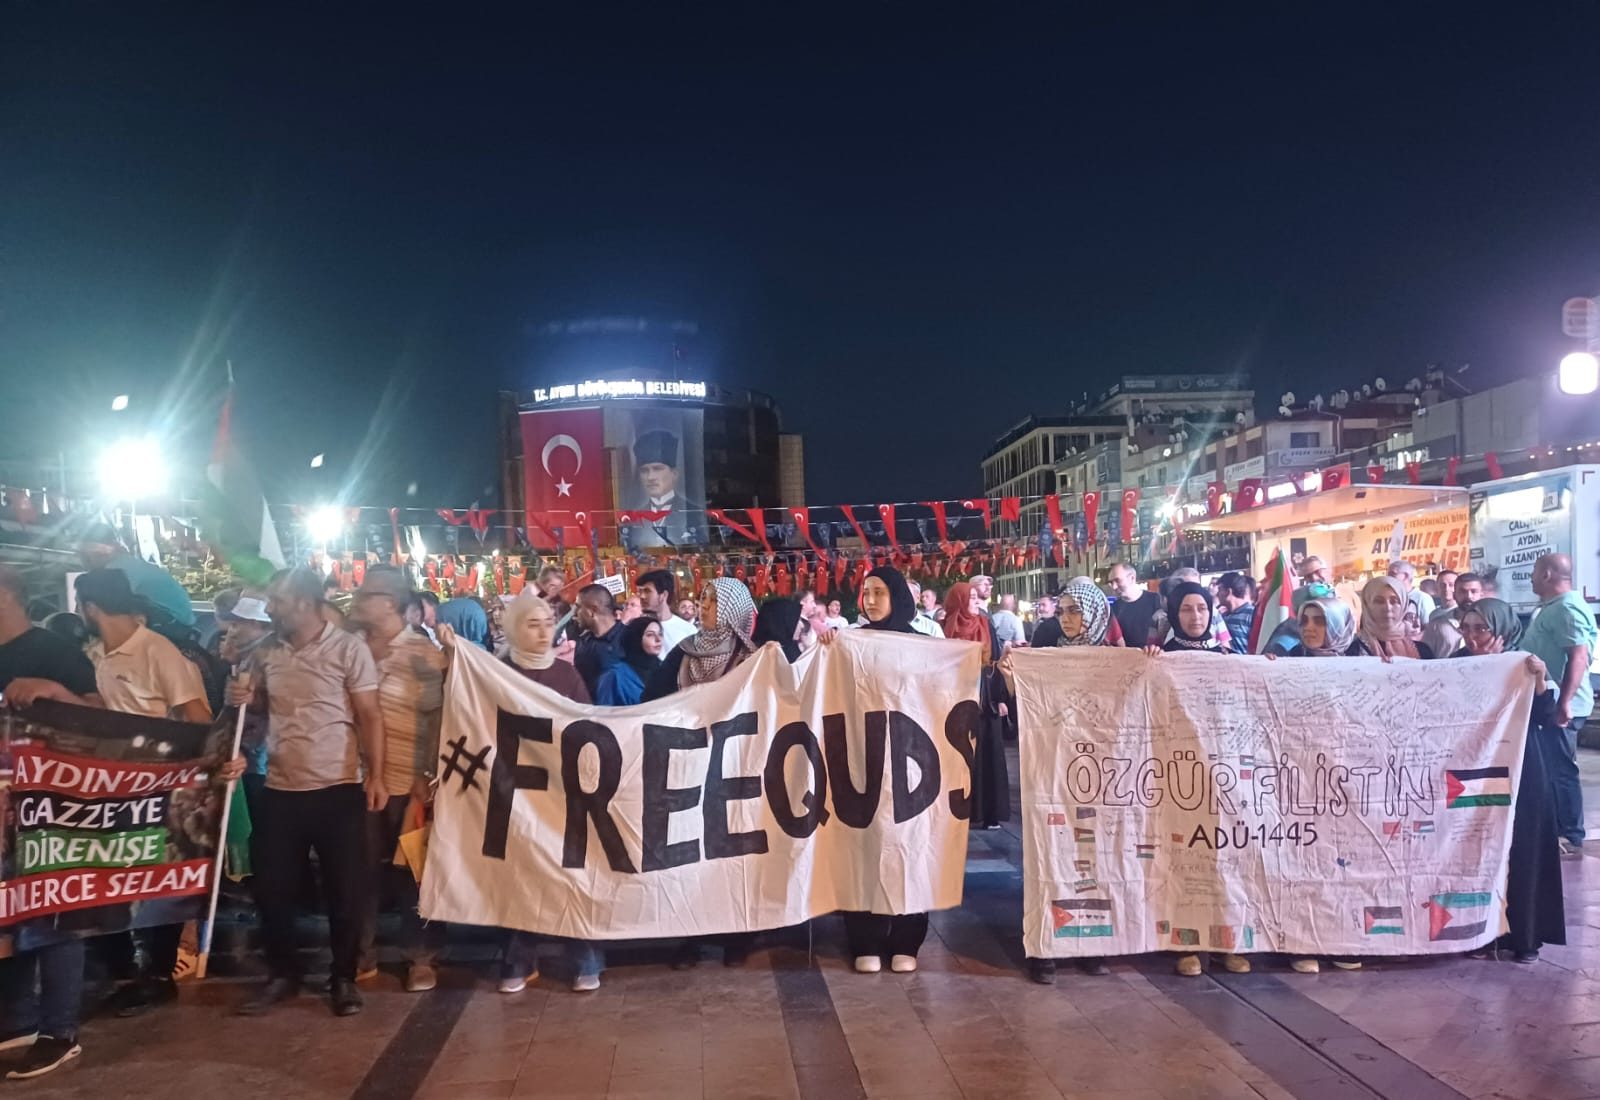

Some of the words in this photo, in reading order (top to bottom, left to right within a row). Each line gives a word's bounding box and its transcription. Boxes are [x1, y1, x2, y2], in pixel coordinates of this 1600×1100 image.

[1371, 530, 1444, 554] AYINLIK
[15, 756, 199, 793] AYDIN'DAN
[1066, 743, 1238, 815] ÖZGÜR
[1252, 752, 1436, 817] FİLİSTİN
[20, 796, 164, 829] GAZZE'YE
[24, 831, 160, 869] DİRENİŞE
[1187, 820, 1319, 850] ADÜ-1445
[105, 863, 209, 897] SELAM
